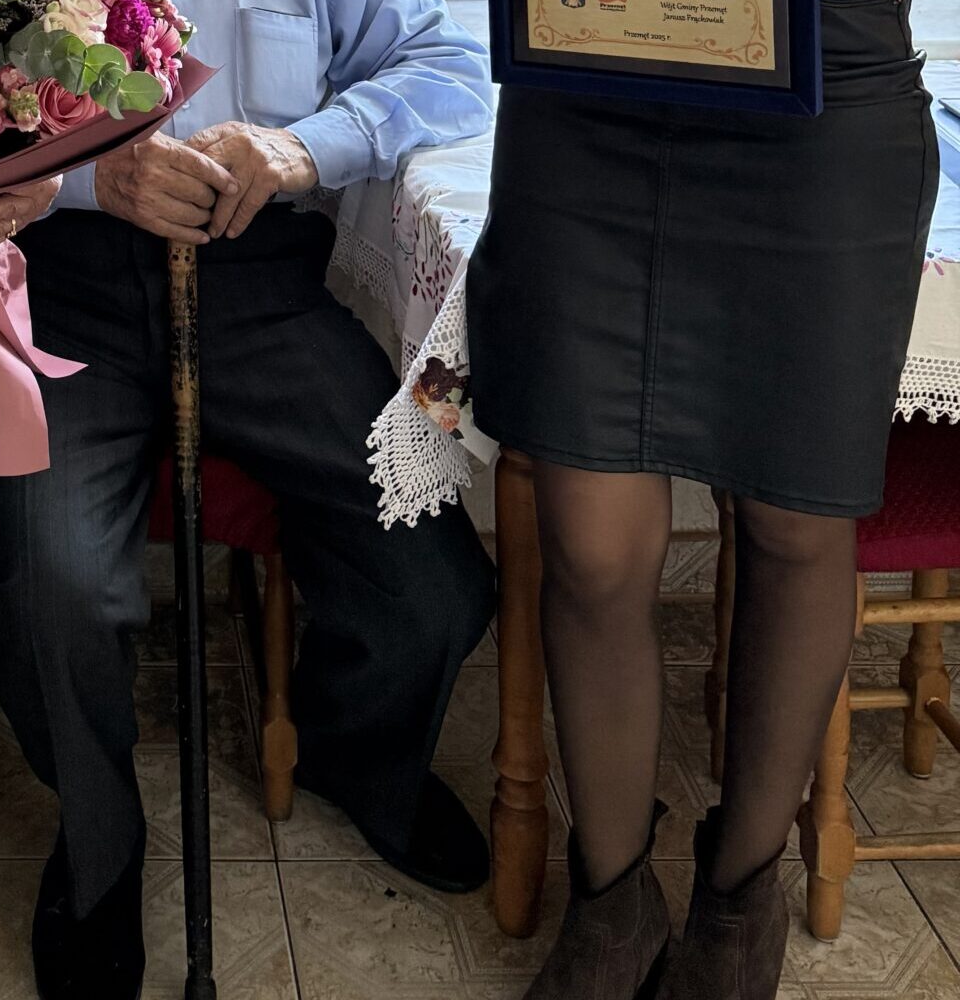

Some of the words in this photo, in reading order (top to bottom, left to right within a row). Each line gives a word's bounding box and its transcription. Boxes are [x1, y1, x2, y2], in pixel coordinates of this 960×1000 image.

[660, 1, 675, 12] Wójt
[676, 3, 699, 13] Gminy
[700, 4, 727, 15] Przemęt
[662, 12, 686, 22] Janusz
[686, 14, 725, 24] Frąckowiak
[623, 29, 649, 40] Przemęt
